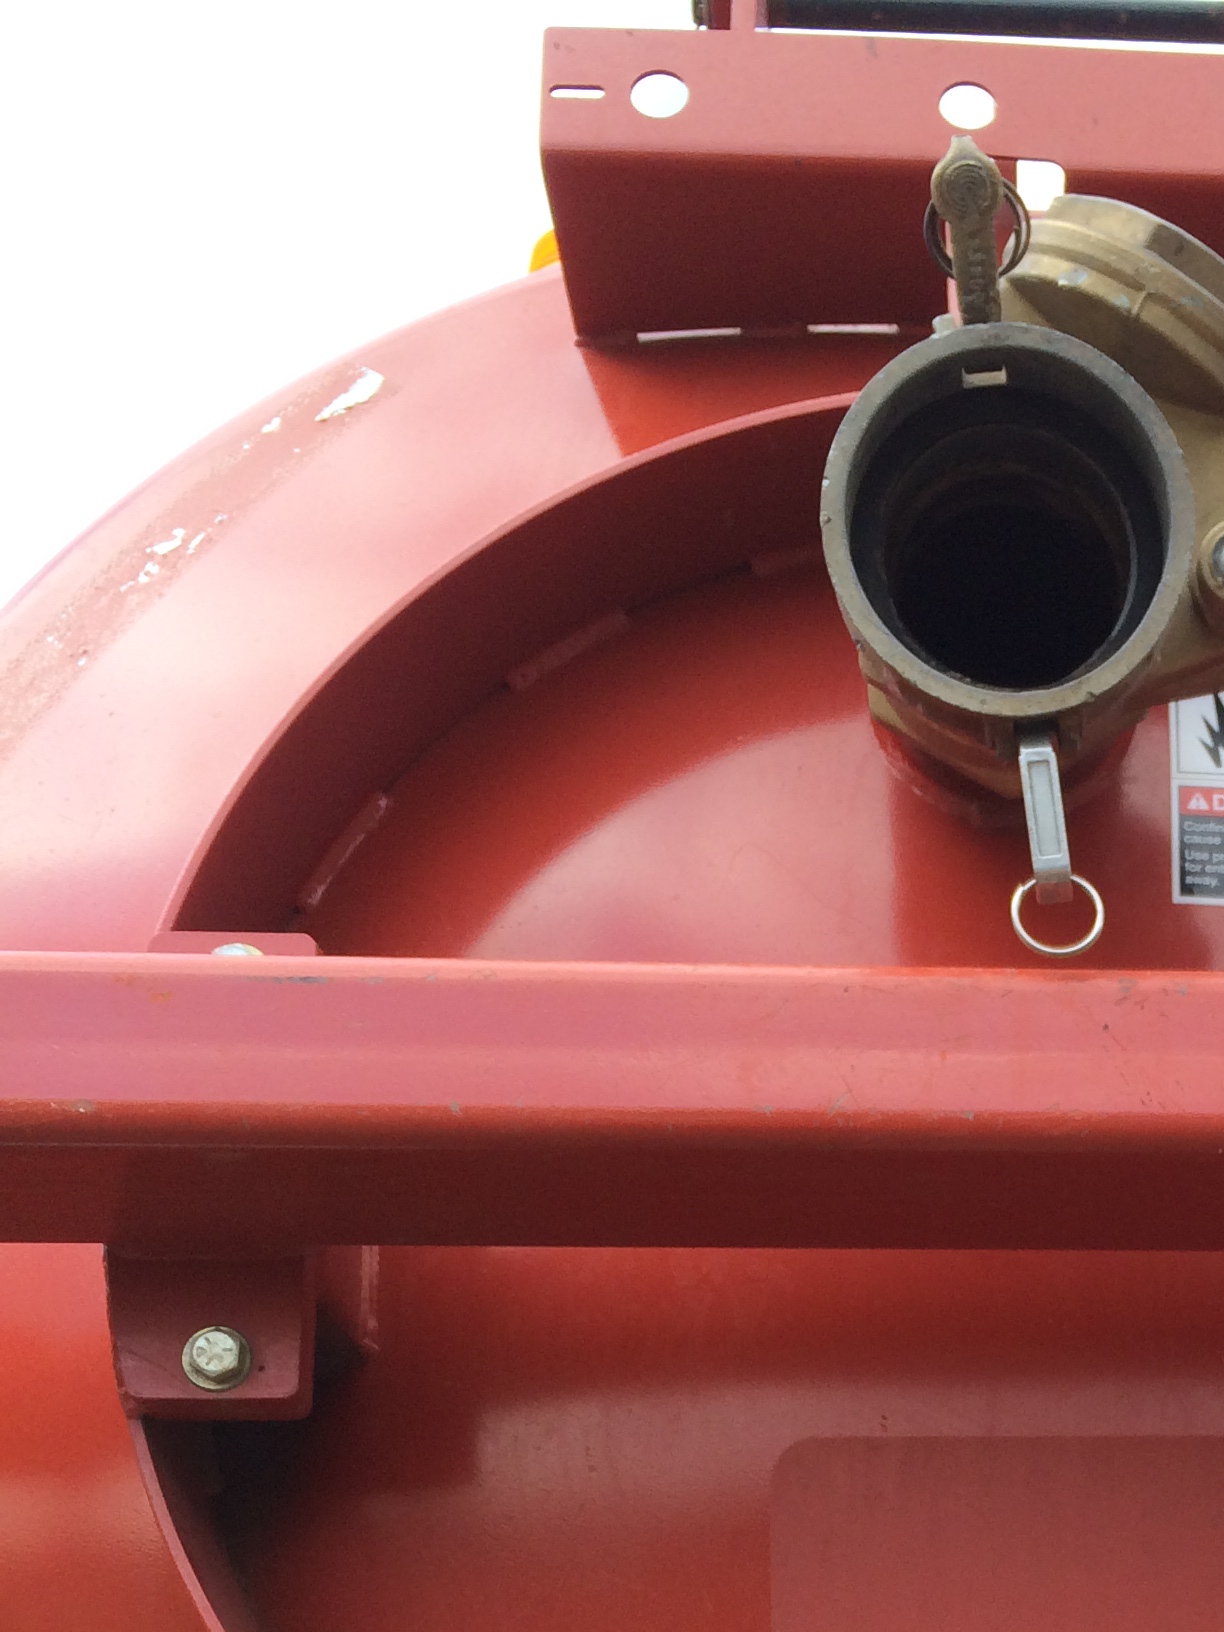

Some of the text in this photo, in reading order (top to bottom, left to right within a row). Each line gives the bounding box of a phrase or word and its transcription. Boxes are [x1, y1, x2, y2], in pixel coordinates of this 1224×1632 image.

[1183, 835, 1222, 845] cause
[1184, 849, 1210, 860] Use
[1184, 861, 1202, 872] for
[1185, 876, 1220, 888] away.
